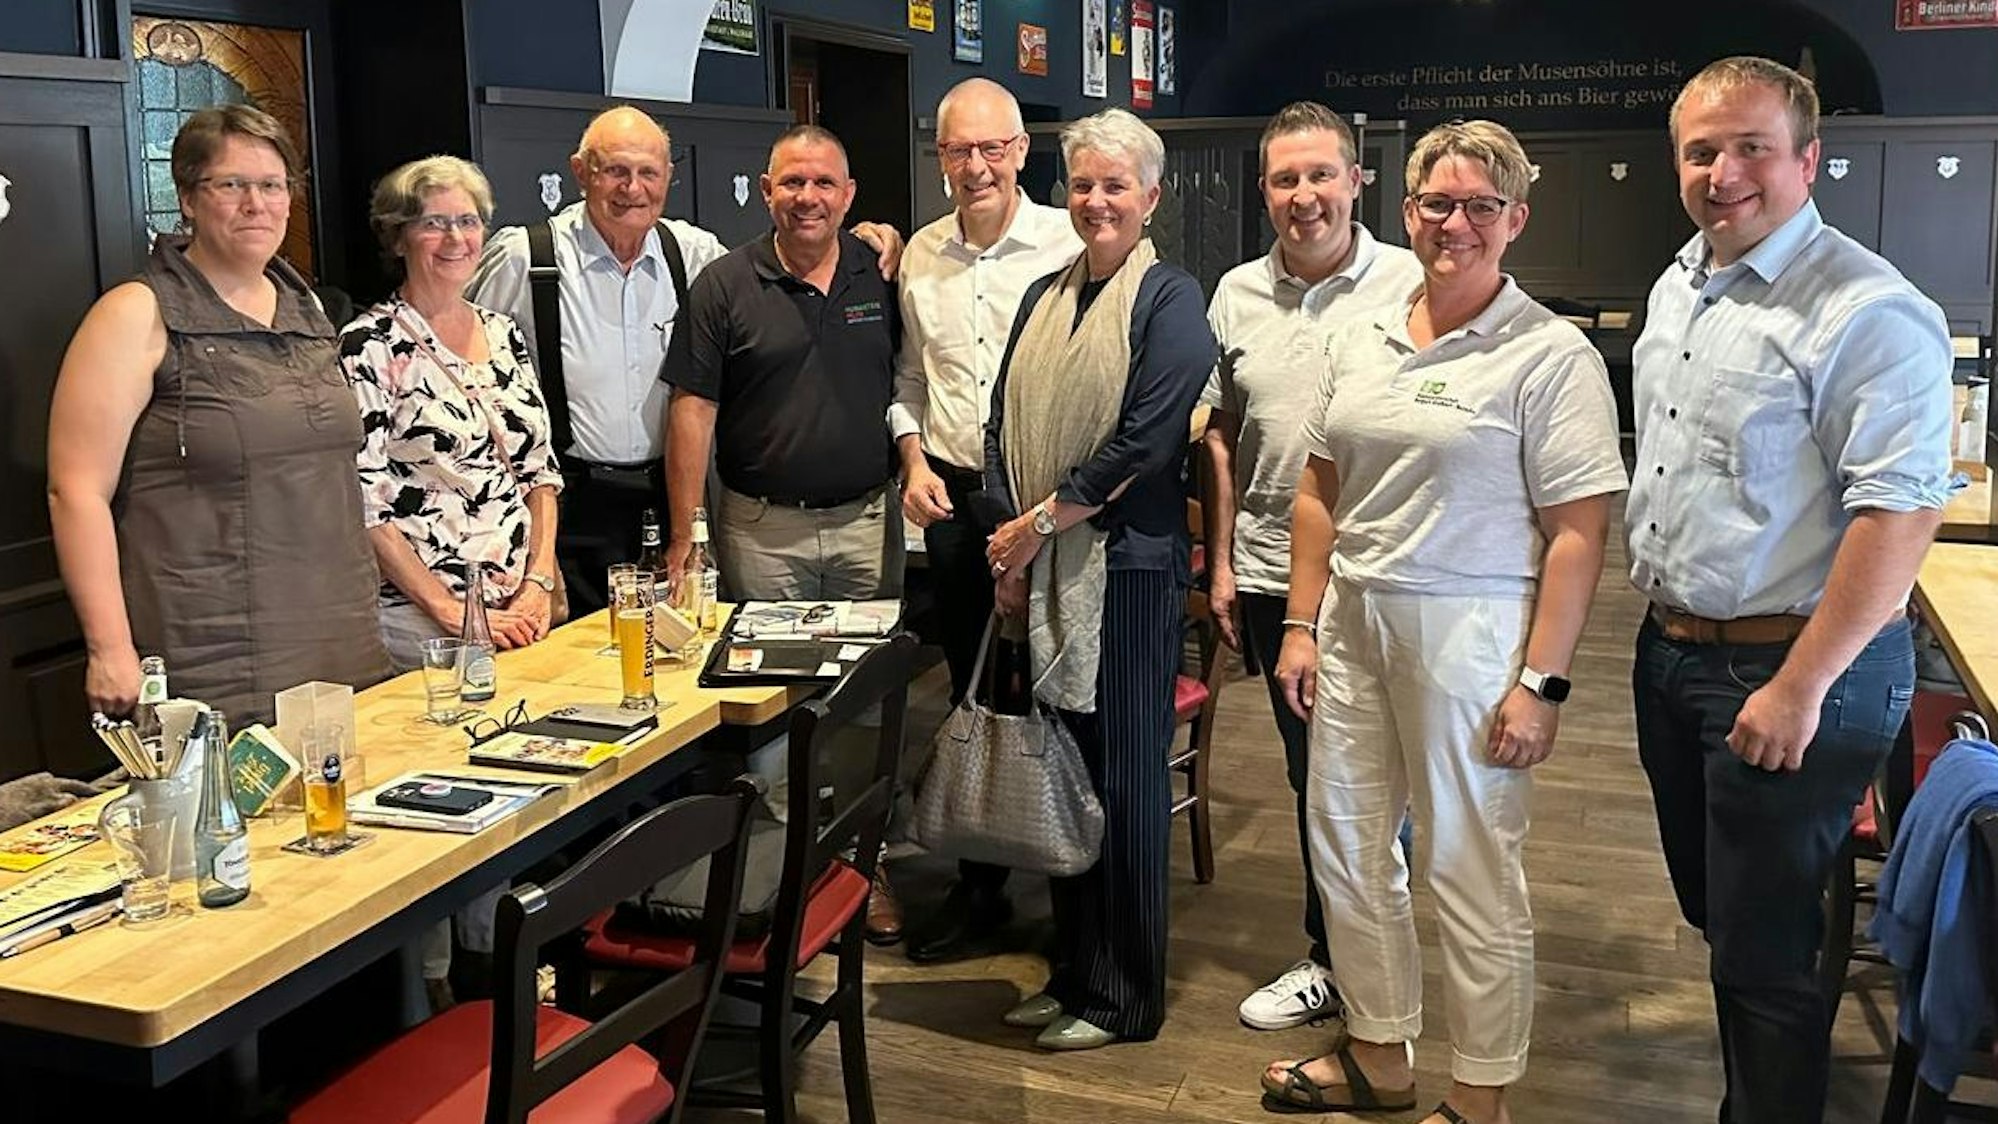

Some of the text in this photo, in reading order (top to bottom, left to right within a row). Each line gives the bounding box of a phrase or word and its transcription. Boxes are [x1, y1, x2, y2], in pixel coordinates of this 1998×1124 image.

[1919, 2, 1965, 15] Berliner
[1325, 57, 1682, 88] Die erste Pflicht der Musensöhne ist,
[1396, 84, 1680, 111] dass man sich ans Bier gewö
[644, 608, 655, 678] ERDINGER
